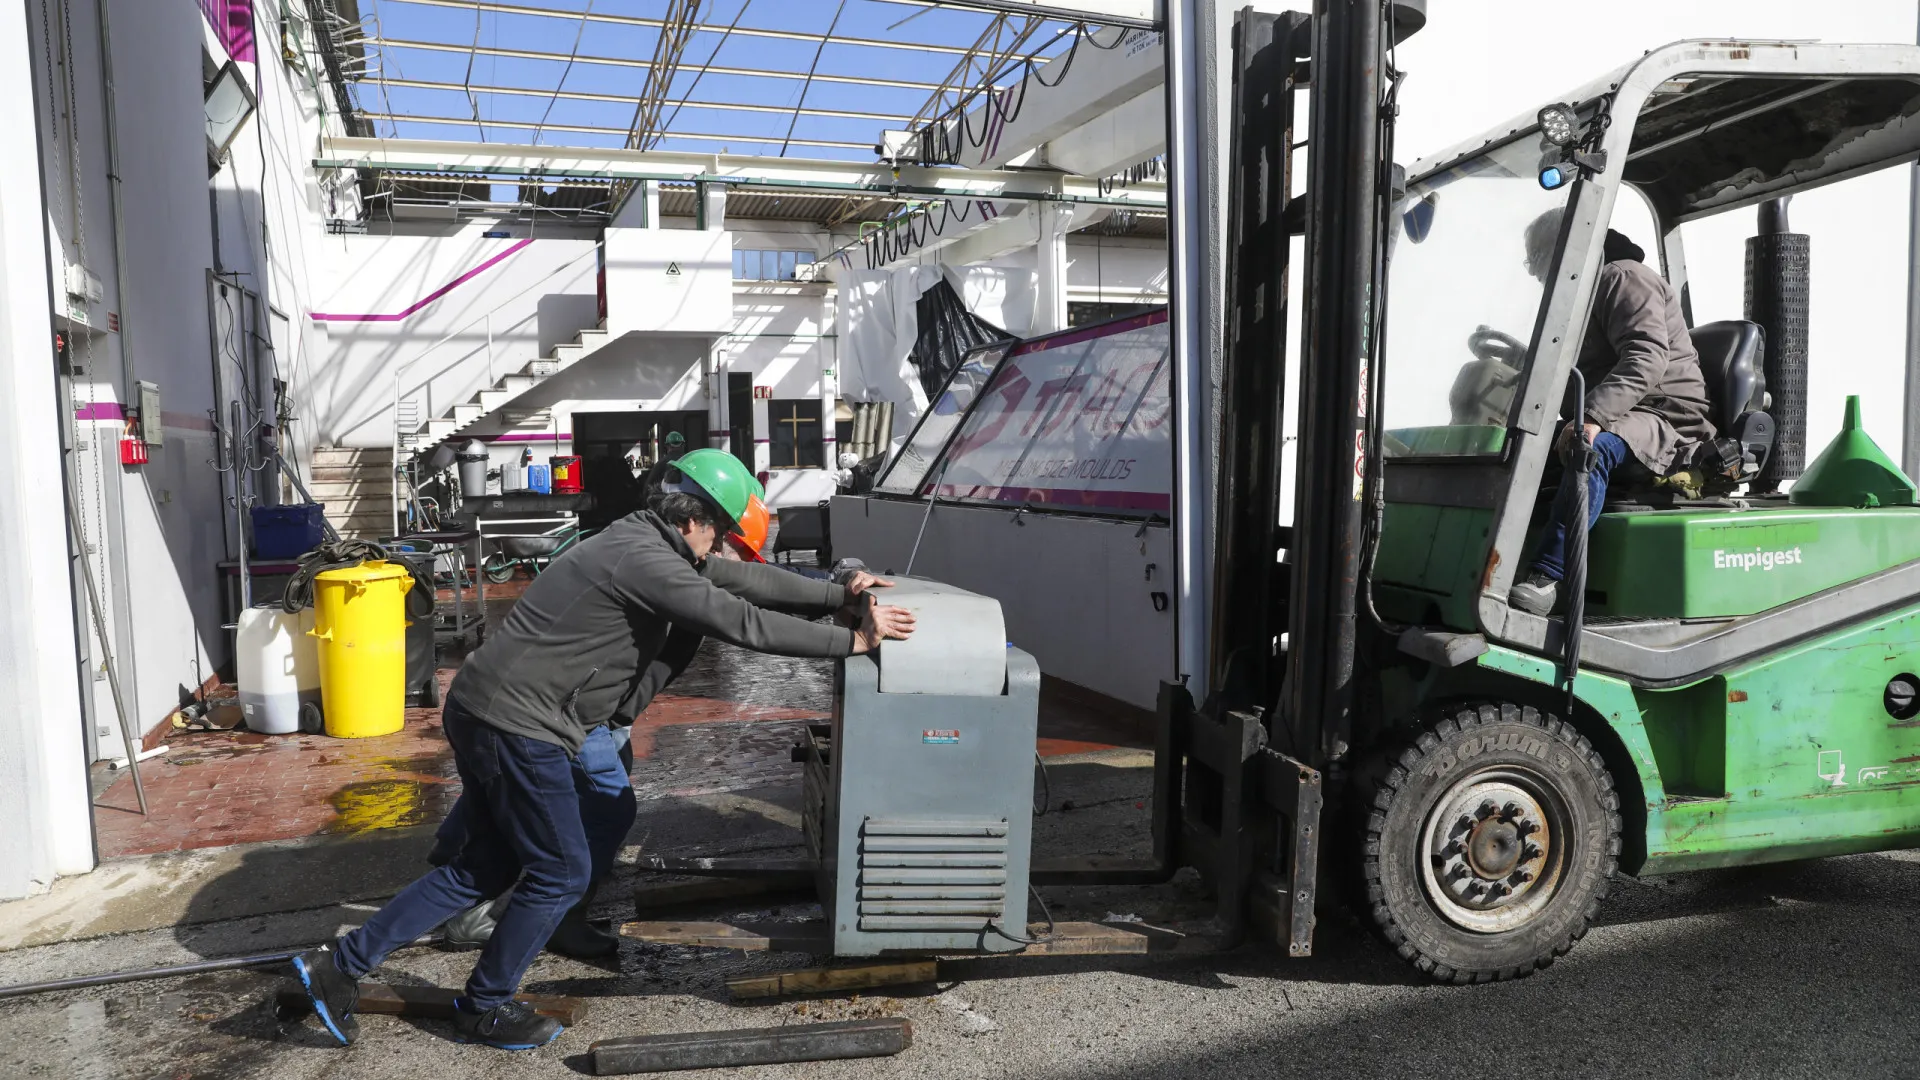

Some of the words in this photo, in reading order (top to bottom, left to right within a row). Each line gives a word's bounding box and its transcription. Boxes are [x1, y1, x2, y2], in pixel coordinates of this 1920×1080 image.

[1039, 459, 1074, 479] SIZE
[1067, 458, 1137, 480] MOULDS
[1713, 546, 1802, 572] Empigest
[1428, 733, 1549, 778] Barum
[1535, 820, 1602, 943] INDUSTRY
